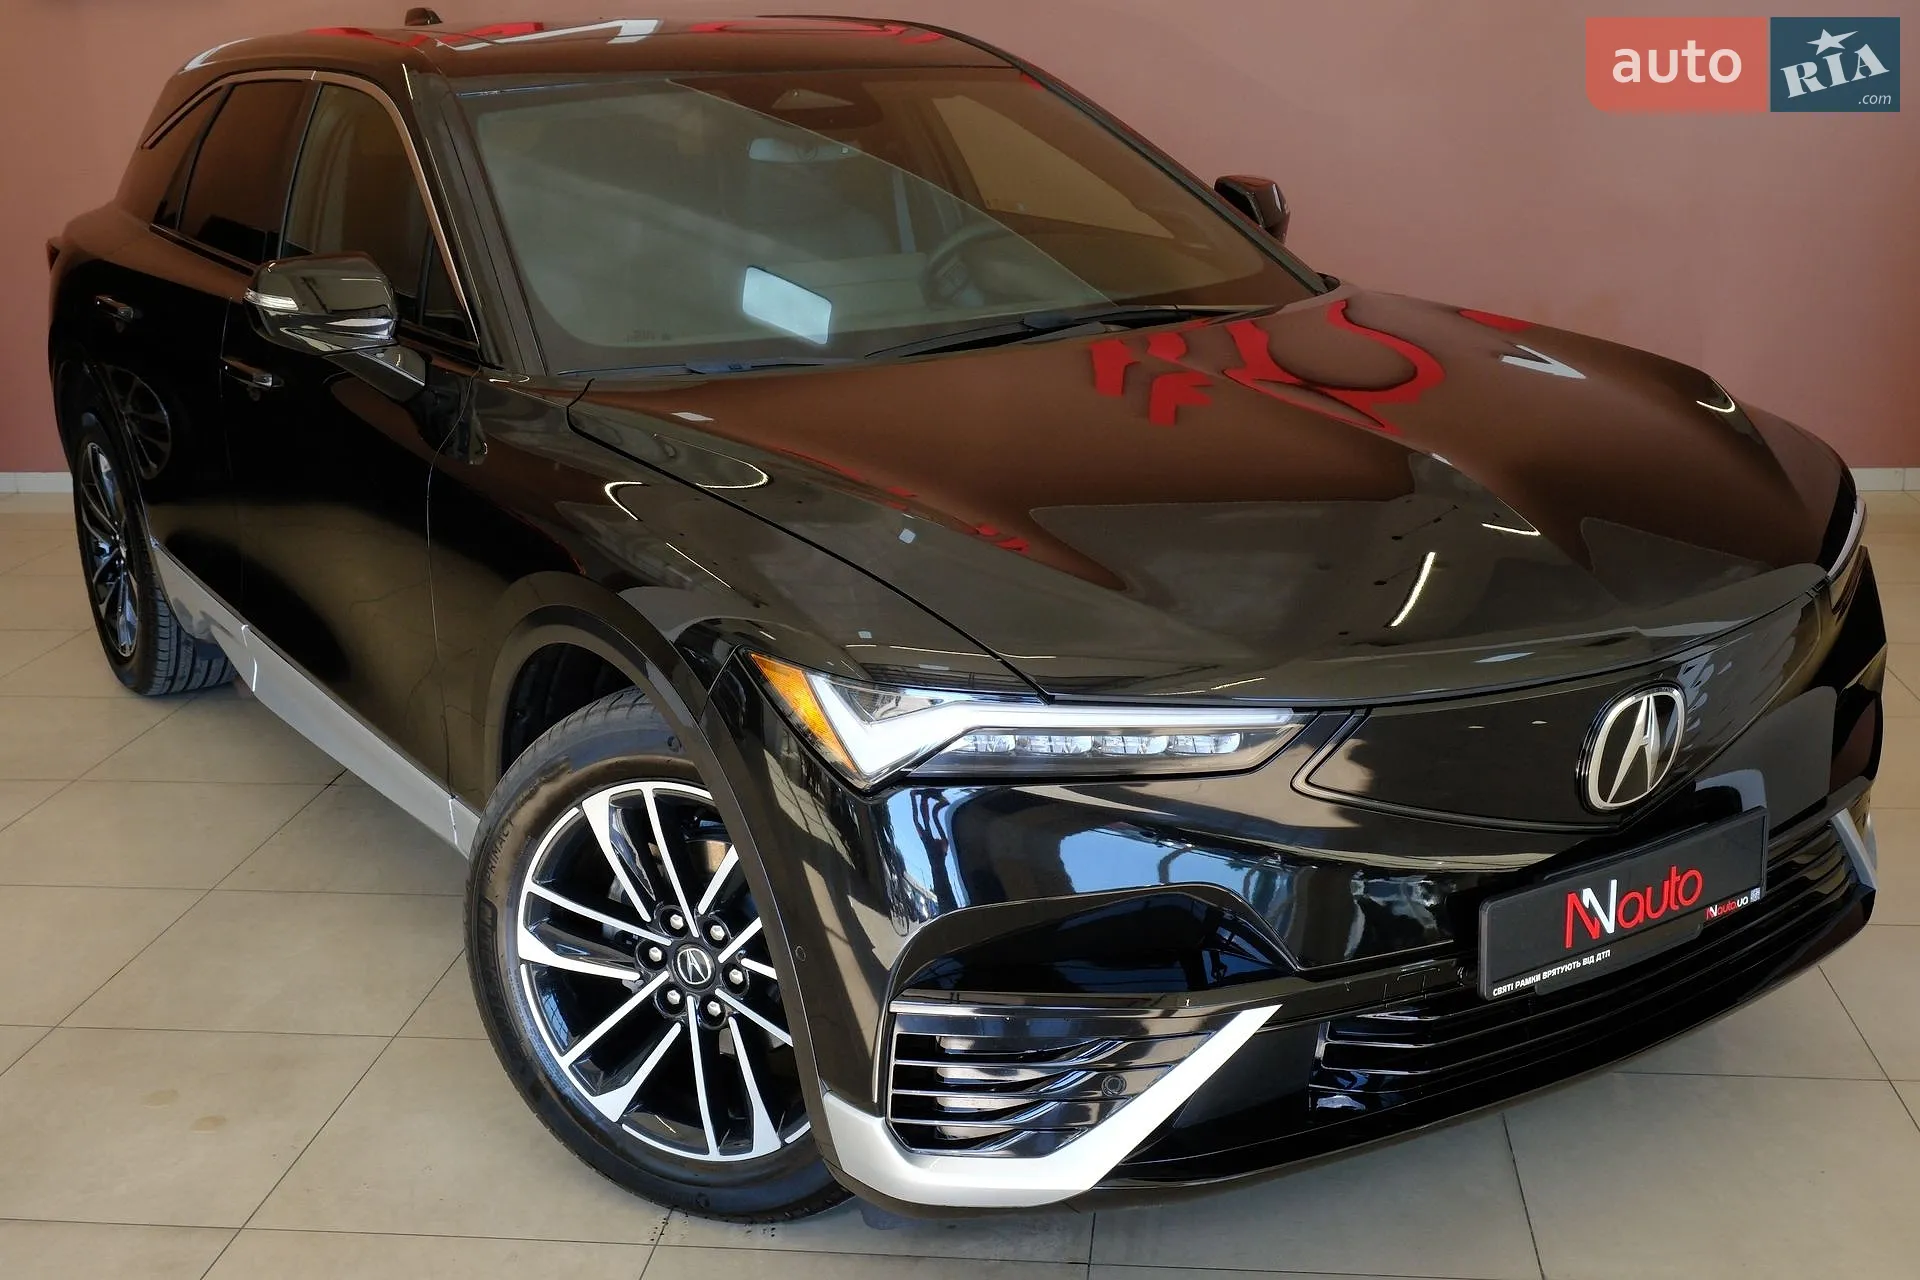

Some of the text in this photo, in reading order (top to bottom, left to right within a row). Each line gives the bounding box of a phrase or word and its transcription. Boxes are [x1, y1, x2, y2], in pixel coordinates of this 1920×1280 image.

[1492, 949, 1611, 997] СВЯТІ РАМКИ ВРЯТУЮТЬ ВІД ДТП
